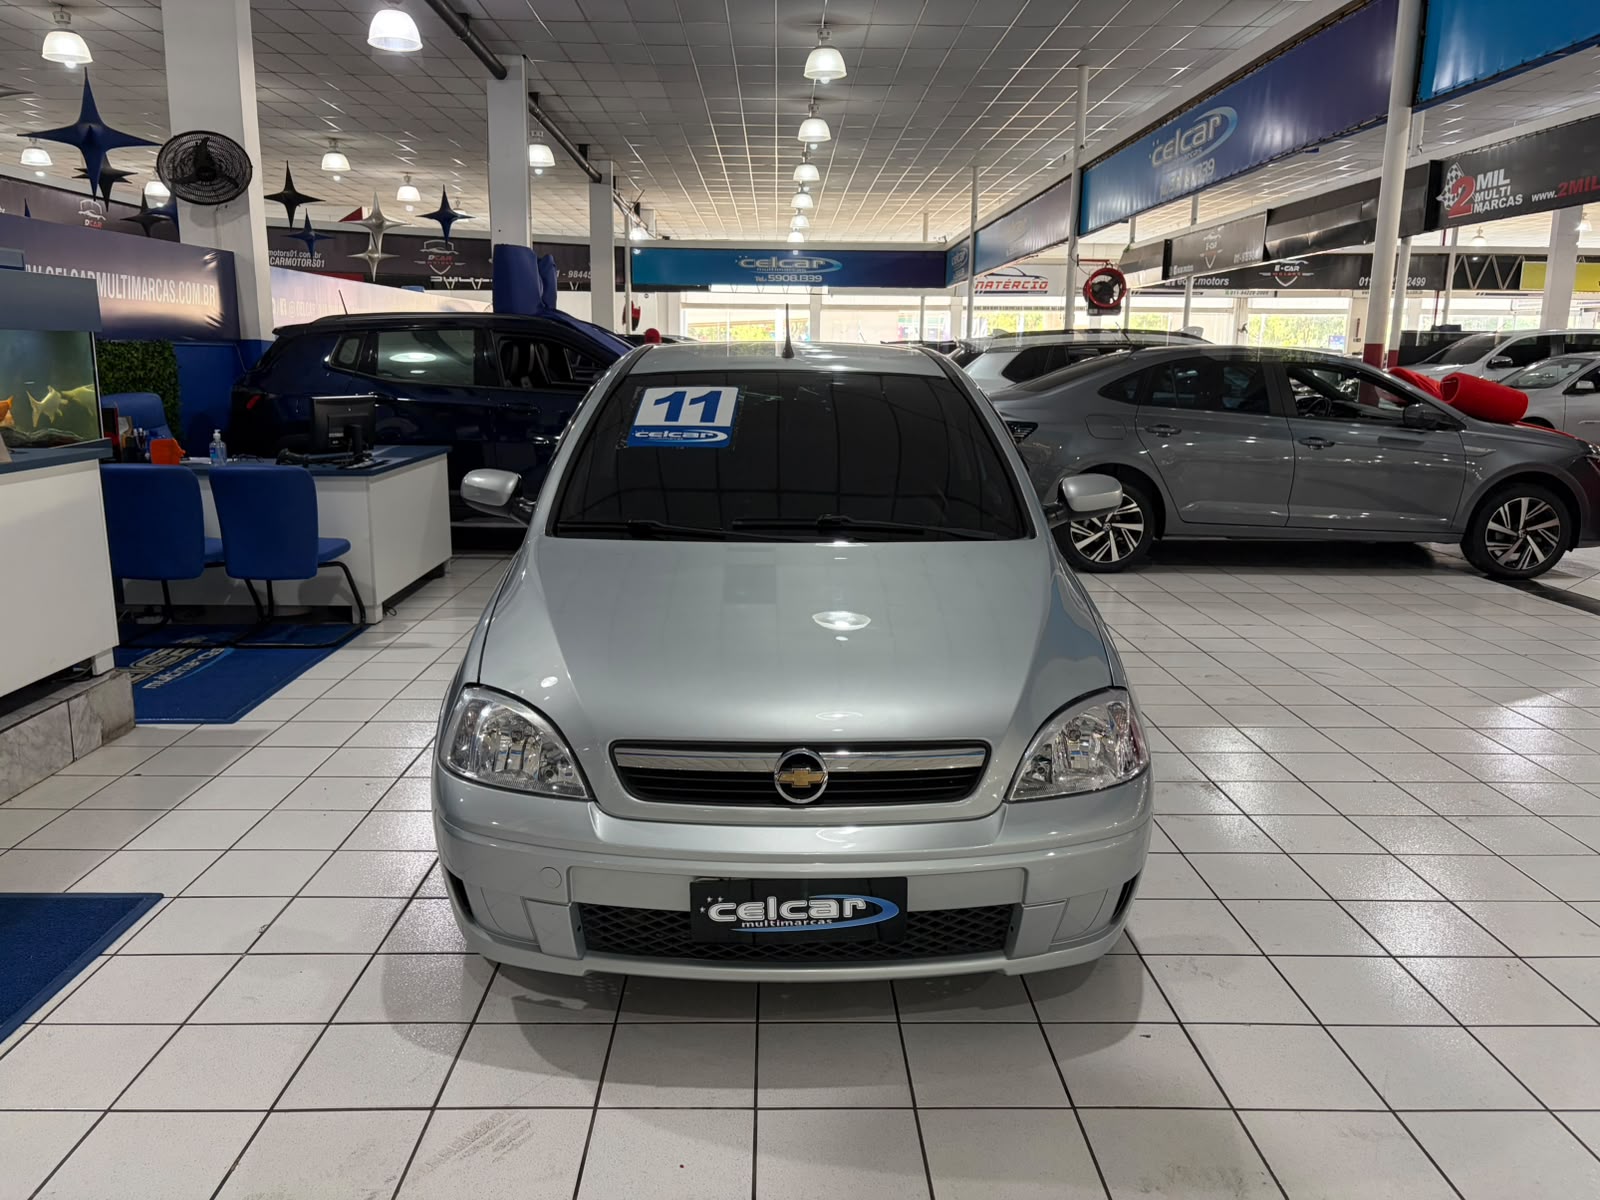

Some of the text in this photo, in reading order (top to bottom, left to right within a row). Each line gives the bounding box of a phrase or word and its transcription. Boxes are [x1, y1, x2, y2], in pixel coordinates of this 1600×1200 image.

[1152, 115, 1222, 168] celcar
[1448, 169, 1511, 217] 2 MIL
[1474, 185, 1512, 203] MULTI
[1473, 194, 1523, 214] MARCAS
[739, 256, 826, 269] celcar
[653, 390, 723, 424] 11
[634, 430, 715, 438] celcar
[707, 896, 867, 923] celcar
[741, 919, 833, 929] multimarcas
